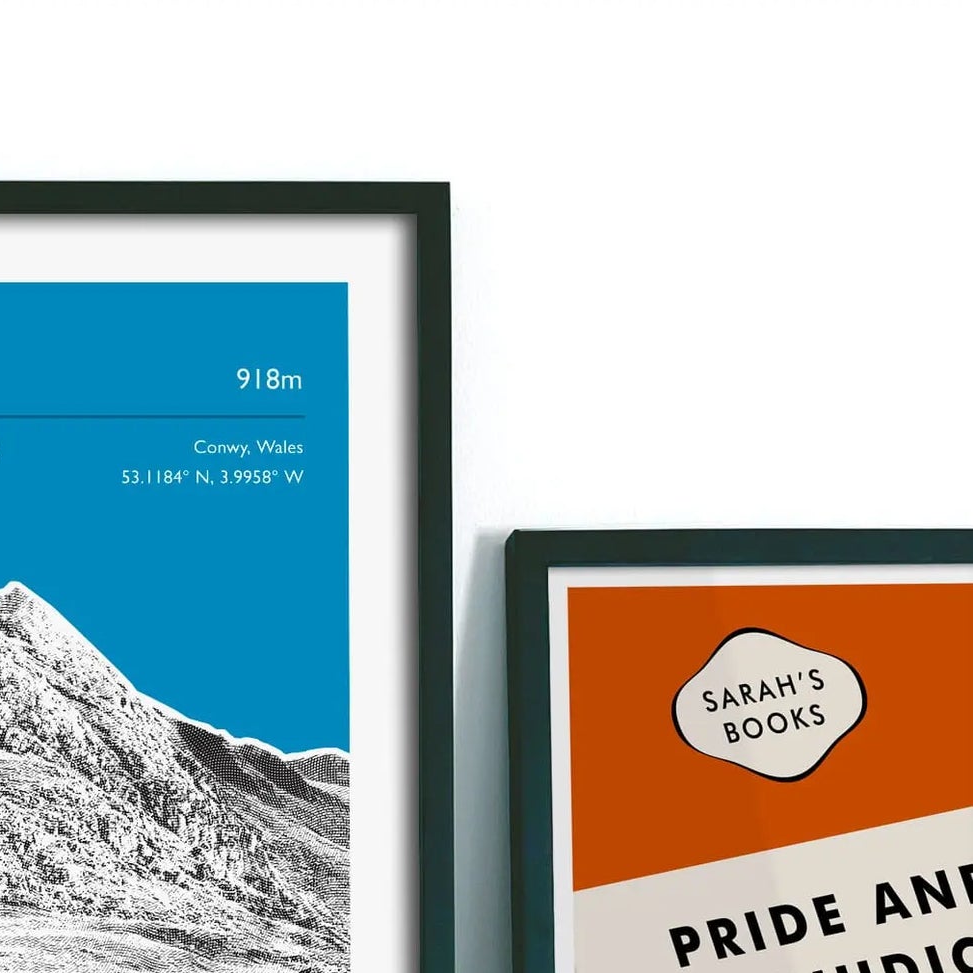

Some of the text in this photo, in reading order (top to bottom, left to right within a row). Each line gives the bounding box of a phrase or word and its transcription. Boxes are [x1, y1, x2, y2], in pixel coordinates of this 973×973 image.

[236, 368, 302, 390] 918m
[194, 439, 304, 458] Conwy, Wales
[195, 469, 214, 485] N,
[284, 469, 304, 484] W
[702, 668, 825, 713] SARAH'S
[723, 704, 825, 744] BOOKS
[668, 893, 846, 968] PRIDE
